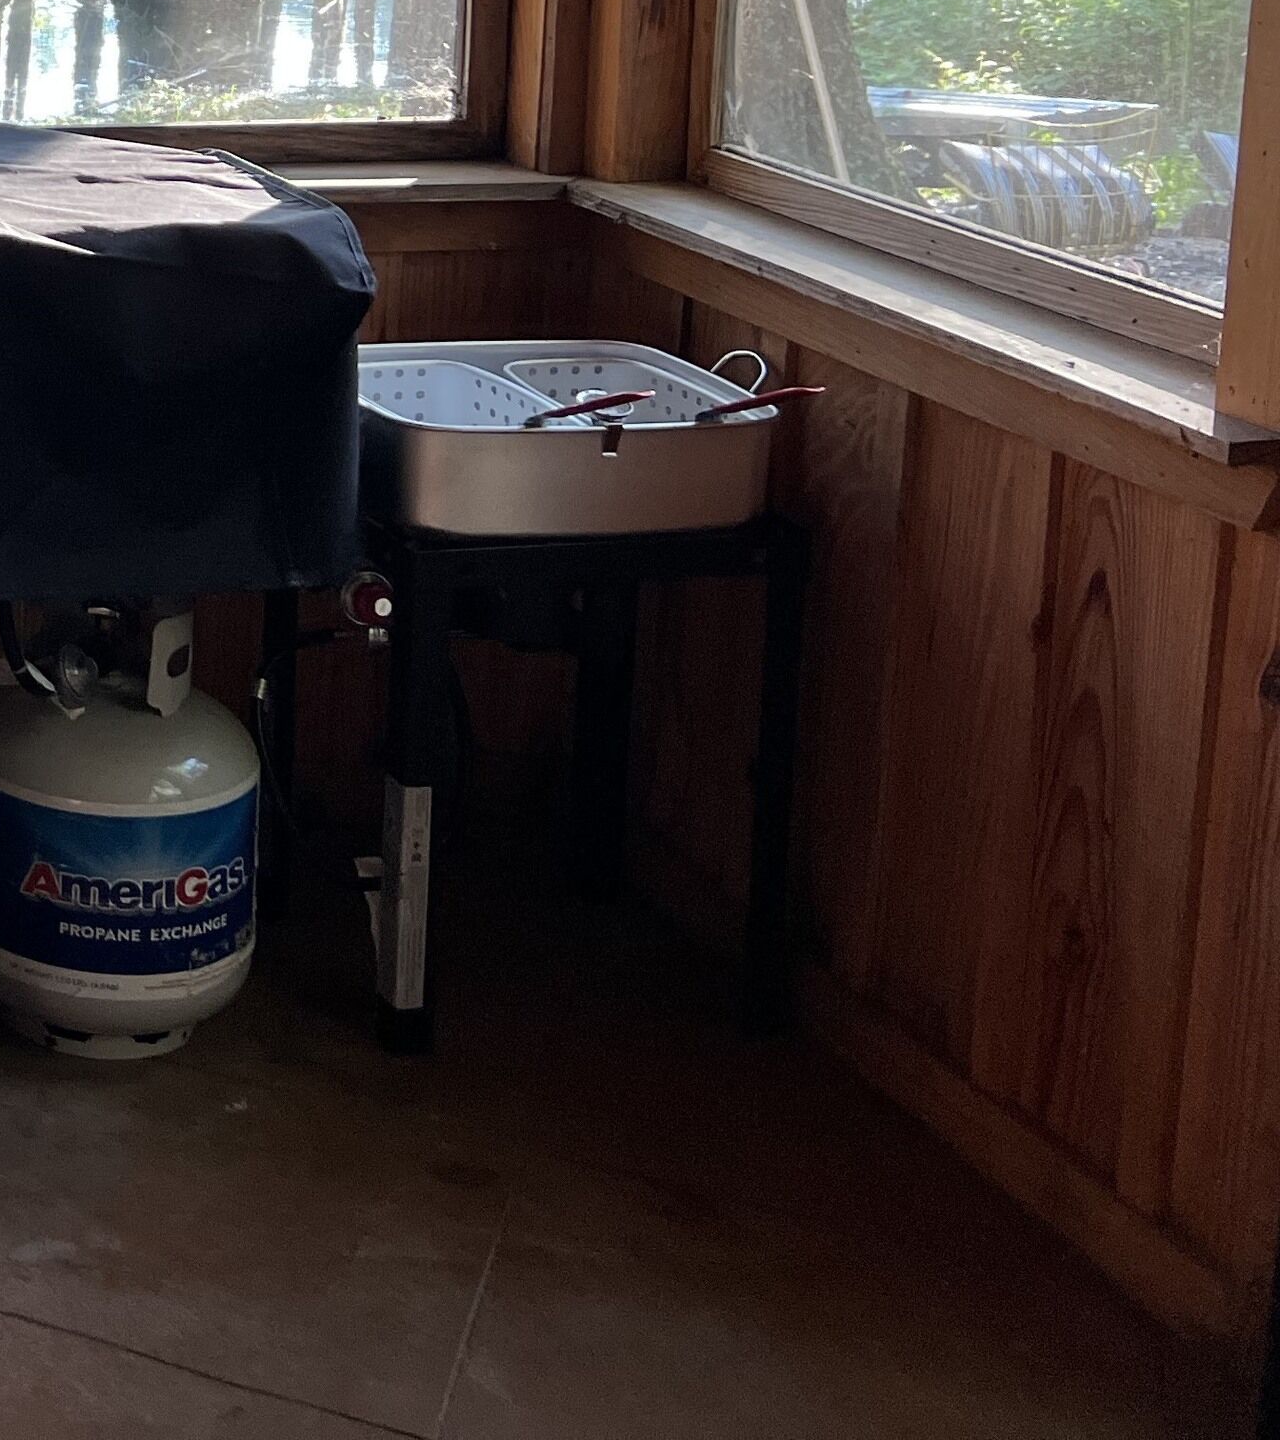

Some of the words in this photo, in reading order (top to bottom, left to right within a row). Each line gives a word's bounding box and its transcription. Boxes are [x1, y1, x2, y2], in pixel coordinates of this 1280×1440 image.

[20, 857, 247, 911] AmeriGas
[58, 921, 141, 942] PROPANE
[150, 913, 228, 942] EXCHANGE
